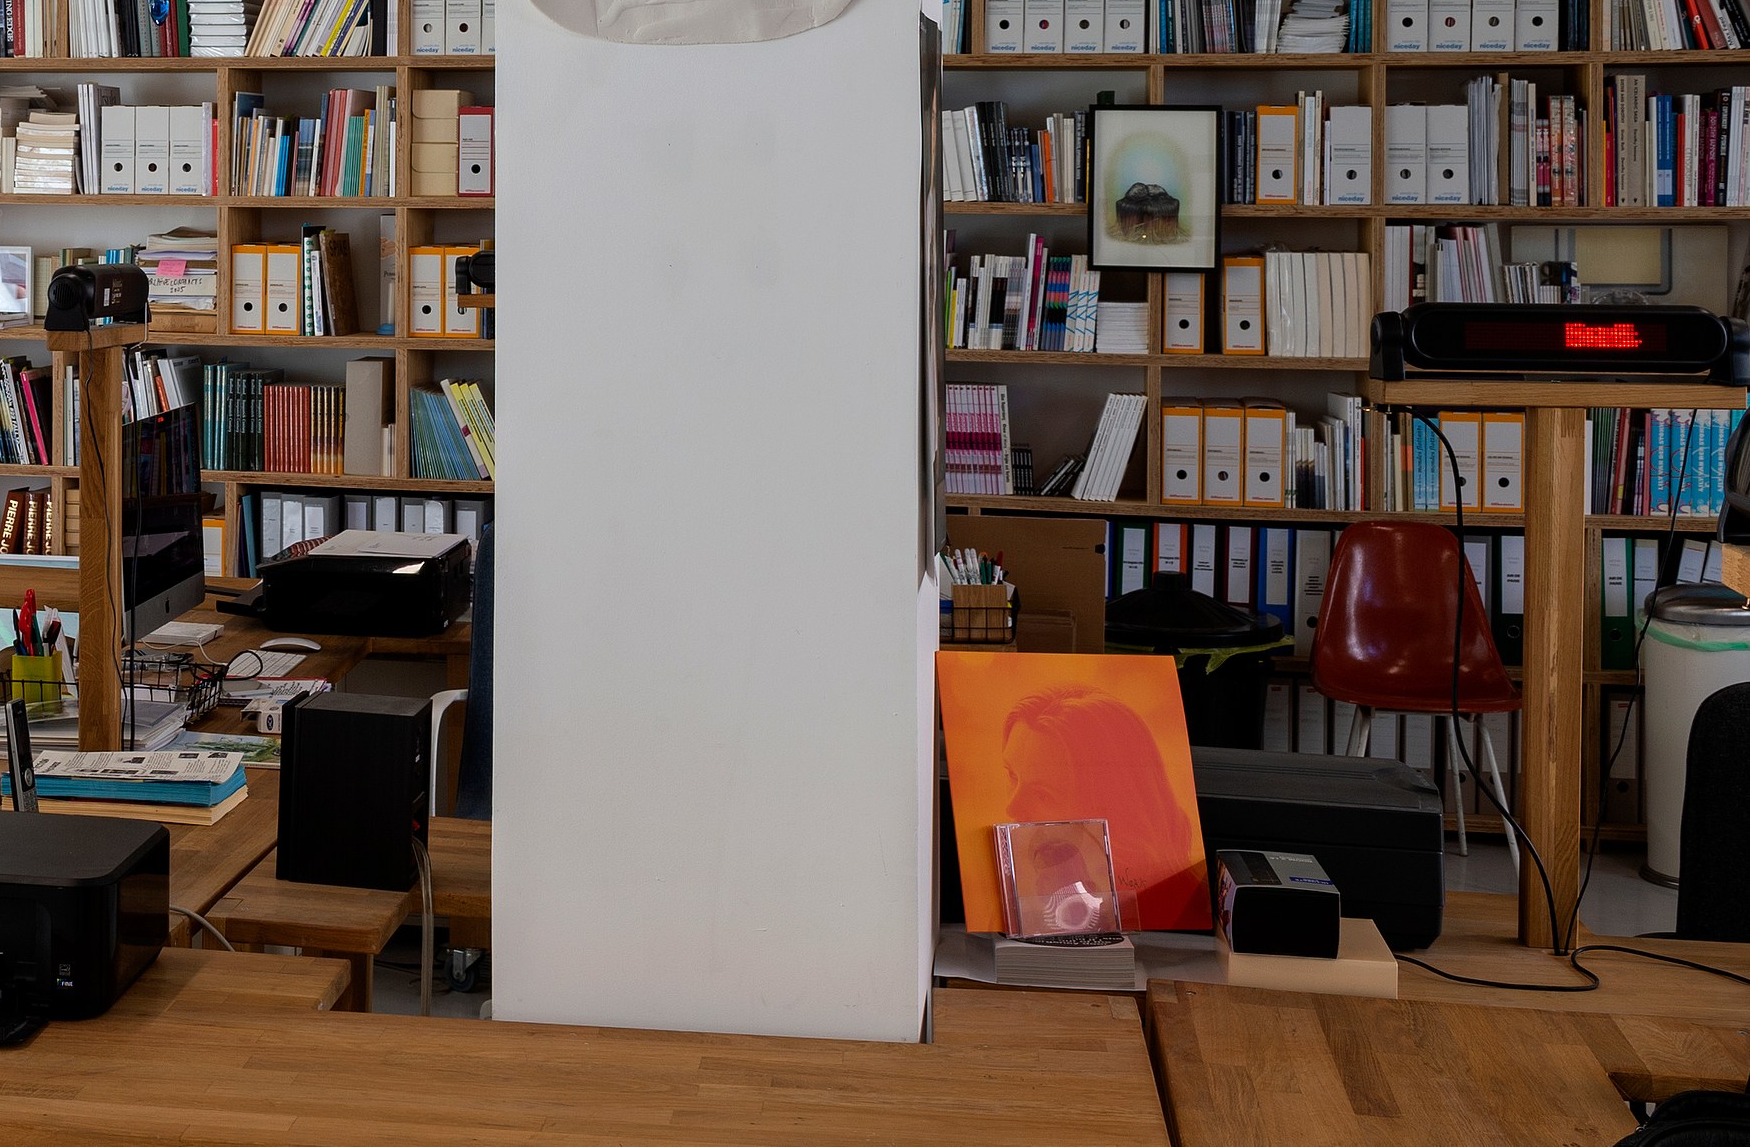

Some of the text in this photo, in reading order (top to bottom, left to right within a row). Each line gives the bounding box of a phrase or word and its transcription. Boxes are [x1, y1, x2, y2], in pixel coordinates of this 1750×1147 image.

[1113, 43, 1136, 51] niceday
[1338, 194, 1365, 202] niceday
[2, 499, 19, 539] PIERRE
[27, 500, 38, 540] PIERRE
